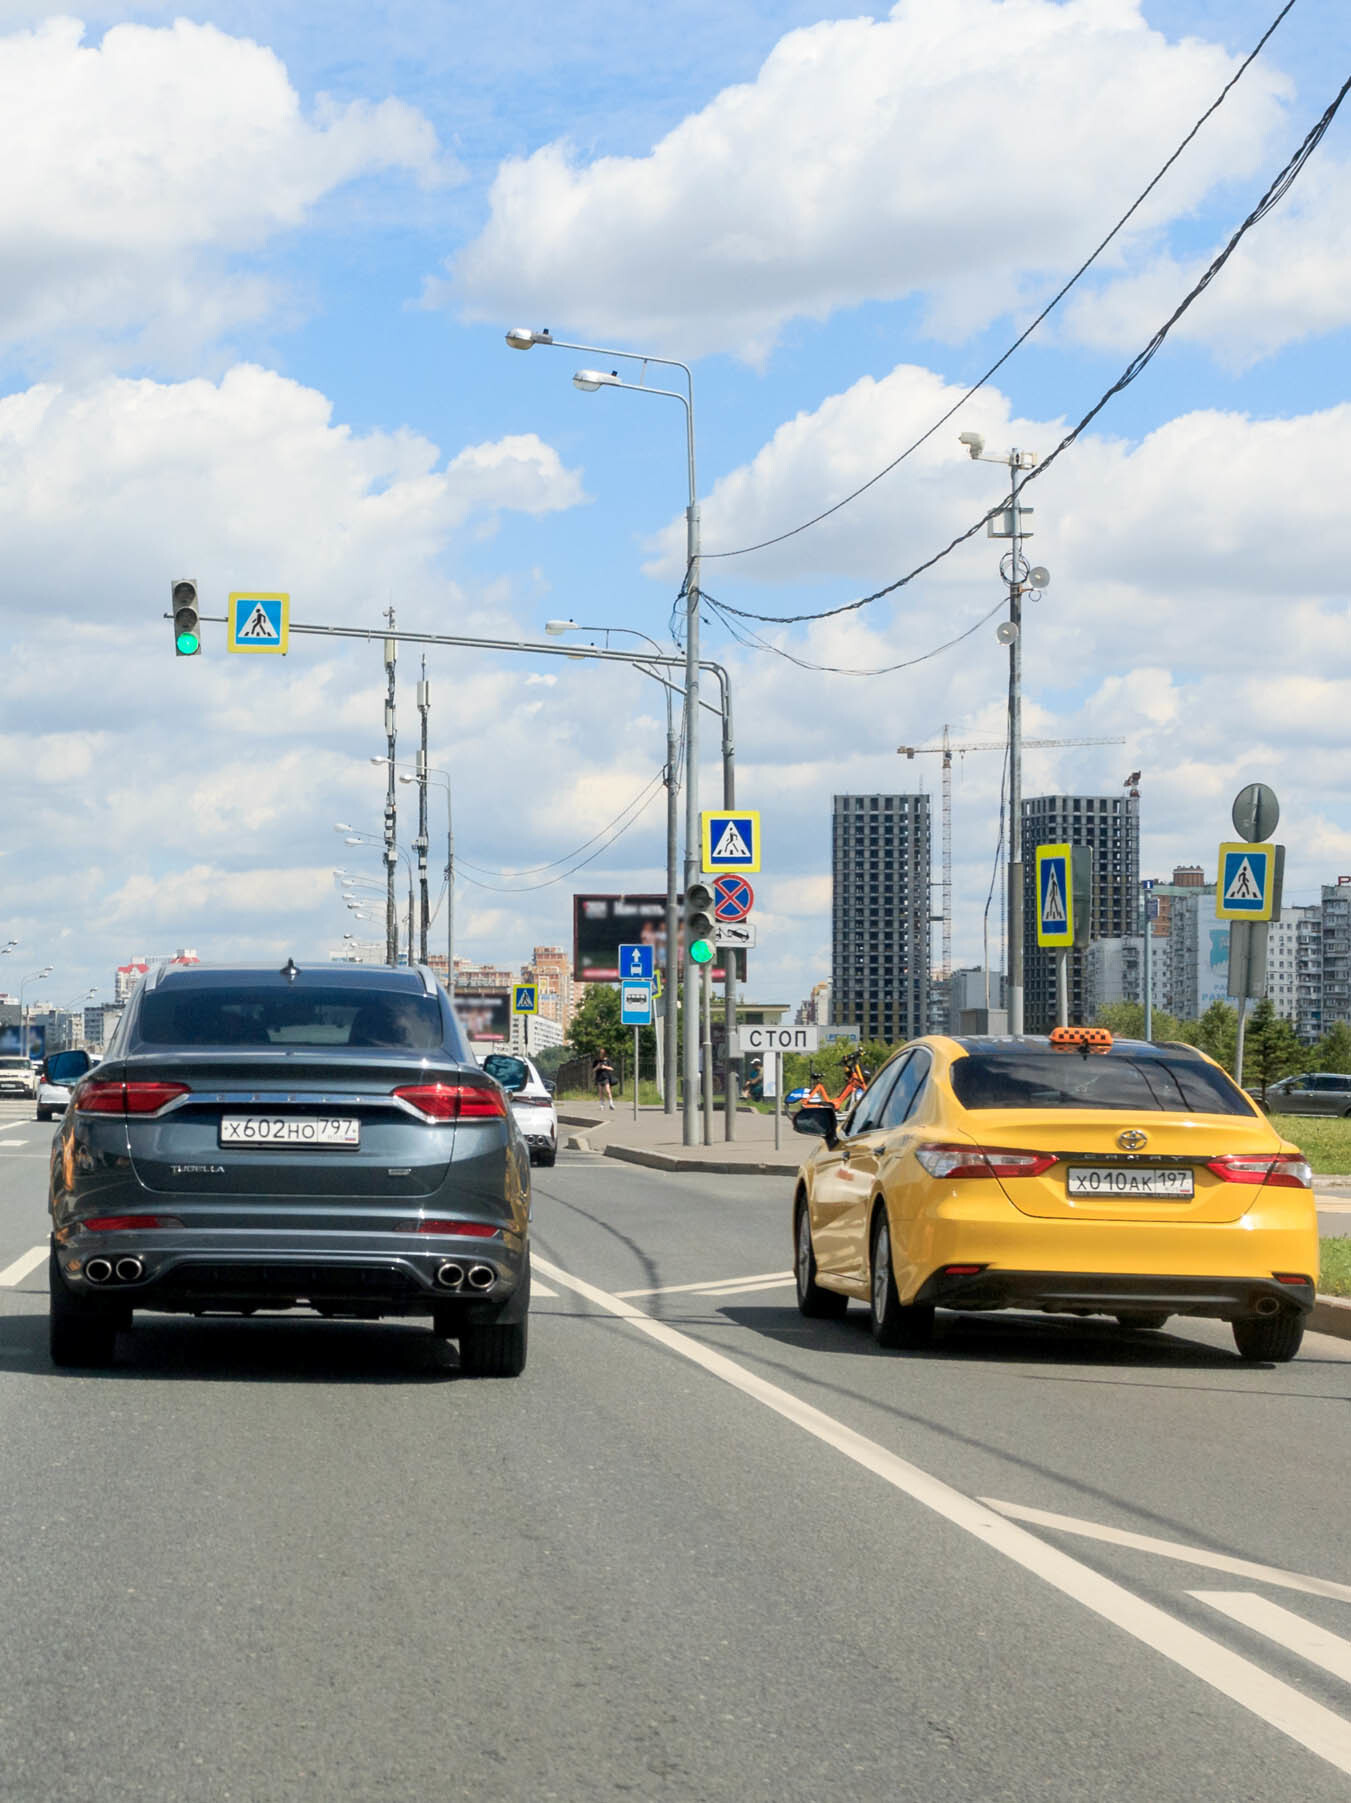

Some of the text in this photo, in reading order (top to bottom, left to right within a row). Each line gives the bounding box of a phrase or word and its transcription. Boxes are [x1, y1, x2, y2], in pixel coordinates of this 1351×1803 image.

[750, 1030, 807, 1047] СТОП
[319, 1118, 353, 1135] 797
[1158, 1171, 1187, 1187] 197
